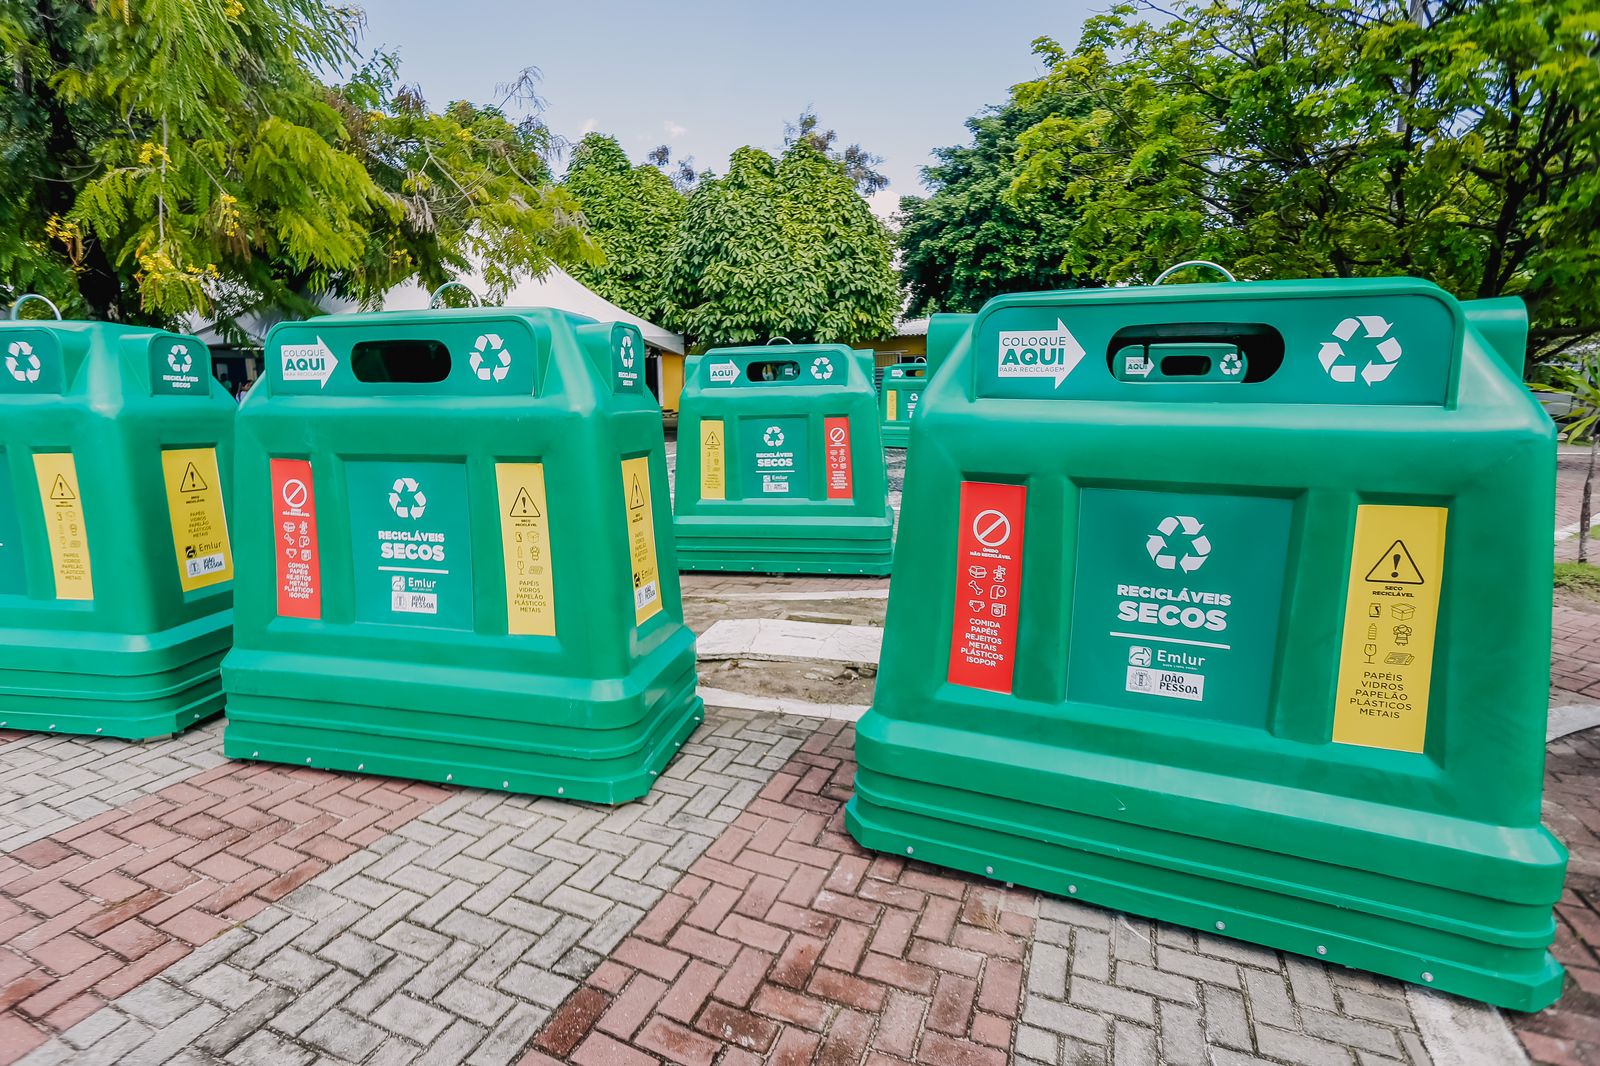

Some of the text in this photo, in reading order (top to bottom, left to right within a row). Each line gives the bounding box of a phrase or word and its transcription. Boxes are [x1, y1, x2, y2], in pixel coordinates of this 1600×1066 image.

[1002, 336, 1066, 346] COLOQUE
[283, 349, 324, 357] COLOQUE
[1001, 348, 1064, 366] AQUI
[284, 358, 325, 371] AQUI
[757, 459, 792, 467] SECOS
[378, 530, 445, 542] RECICLÁVEIS
[199, 541, 222, 552] Emlur
[380, 542, 445, 562] SECOS
[408, 577, 436, 588] Emlur
[1117, 584, 1231, 606] RECICLÁVEIS
[1117, 601, 1227, 631] SECOS
[969, 618, 1001, 628] COMIDA
[971, 625, 998, 636] PAPÉIS
[965, 633, 1002, 645] REJEITOS
[968, 641, 997, 652] METAIS
[961, 647, 1004, 661] PLÁSTICOS
[1157, 650, 1206, 666] Emlur
[966, 656, 996, 668] ISOPOR
[1160, 673, 1184, 684] JOÃO
[1364, 671, 1403, 682] PAPÉIS
[1160, 682, 1198, 694] PESSOA
[1361, 680, 1404, 691] VIDROS
[1355, 689, 1408, 700] PAPELÃO
[1350, 698, 1412, 711] PLÁSTICOS
[1359, 708, 1400, 719] METAIS
